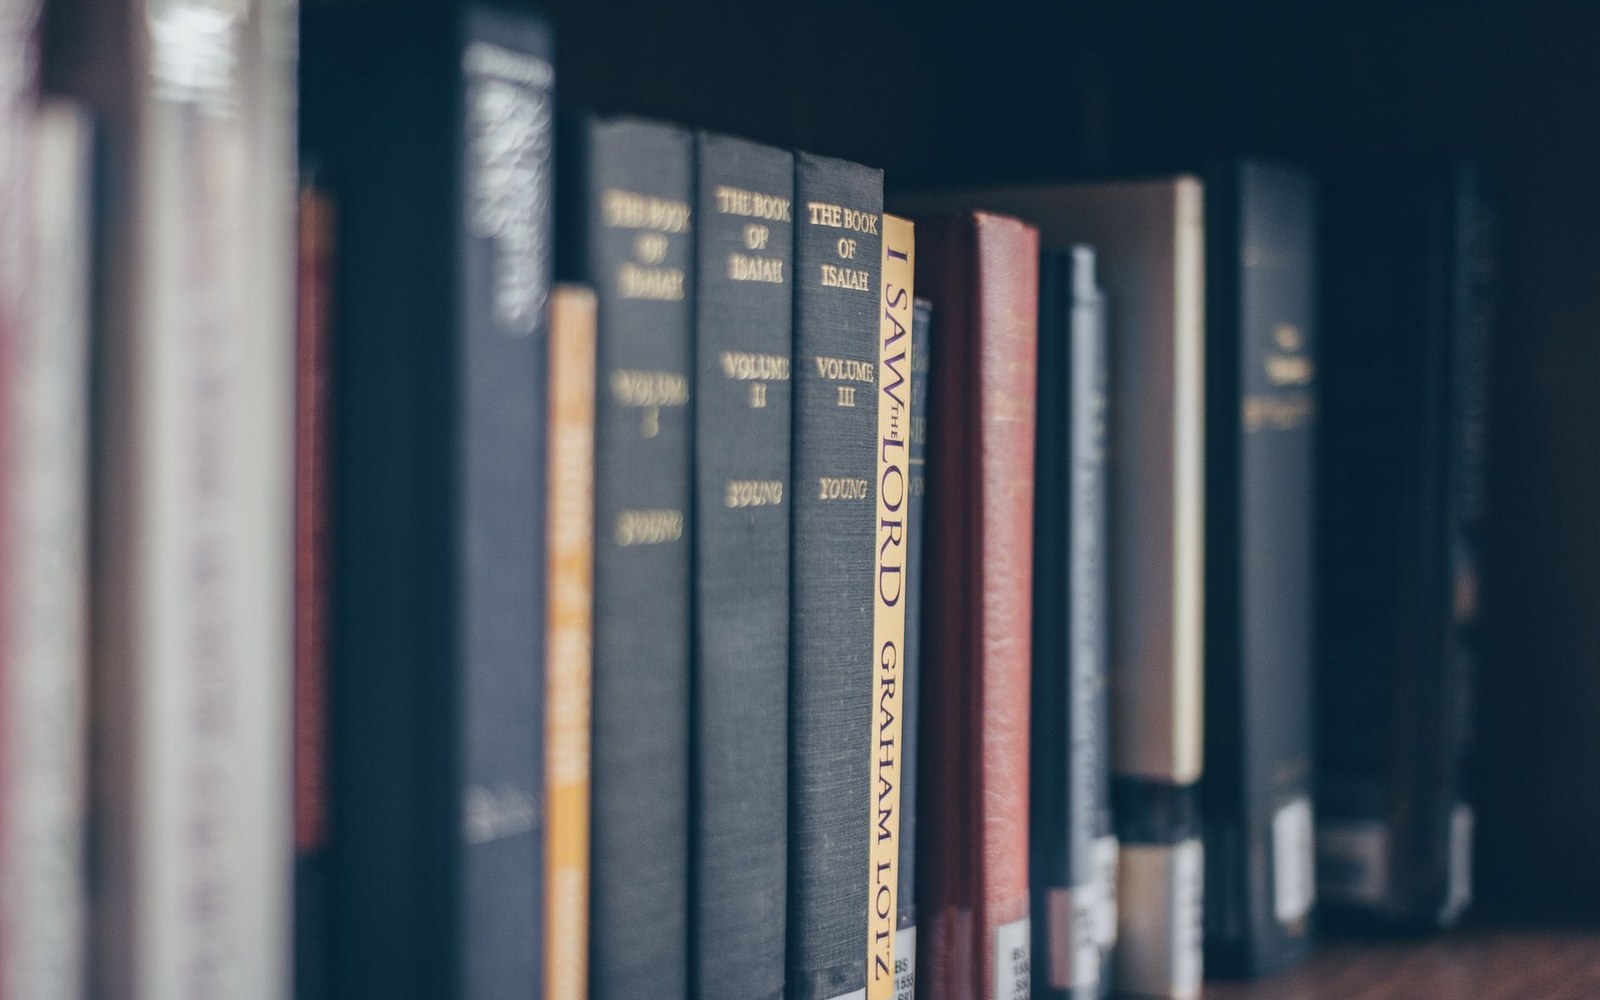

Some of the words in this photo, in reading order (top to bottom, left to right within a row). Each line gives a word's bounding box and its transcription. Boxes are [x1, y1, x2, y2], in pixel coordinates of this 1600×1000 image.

[751, 191, 791, 222] BOOK
[808, 202, 841, 227] THE
[844, 210, 878, 235] BOOK
[838, 238, 857, 259] OF
[887, 245, 908, 264] I
[821, 264, 869, 291] ISAIAH
[883, 283, 907, 415] SAW
[816, 357, 874, 383] VOLUME
[751, 382, 767, 408] II
[838, 386, 856, 407] III
[727, 480, 783, 507] YOUNG
[820, 477, 868, 499] YOUNG
[880, 435, 904, 607] LORD
[878, 641, 897, 843] GRAHAM
[875, 860, 892, 981] LOTZ
[895, 958, 908, 974] BS
